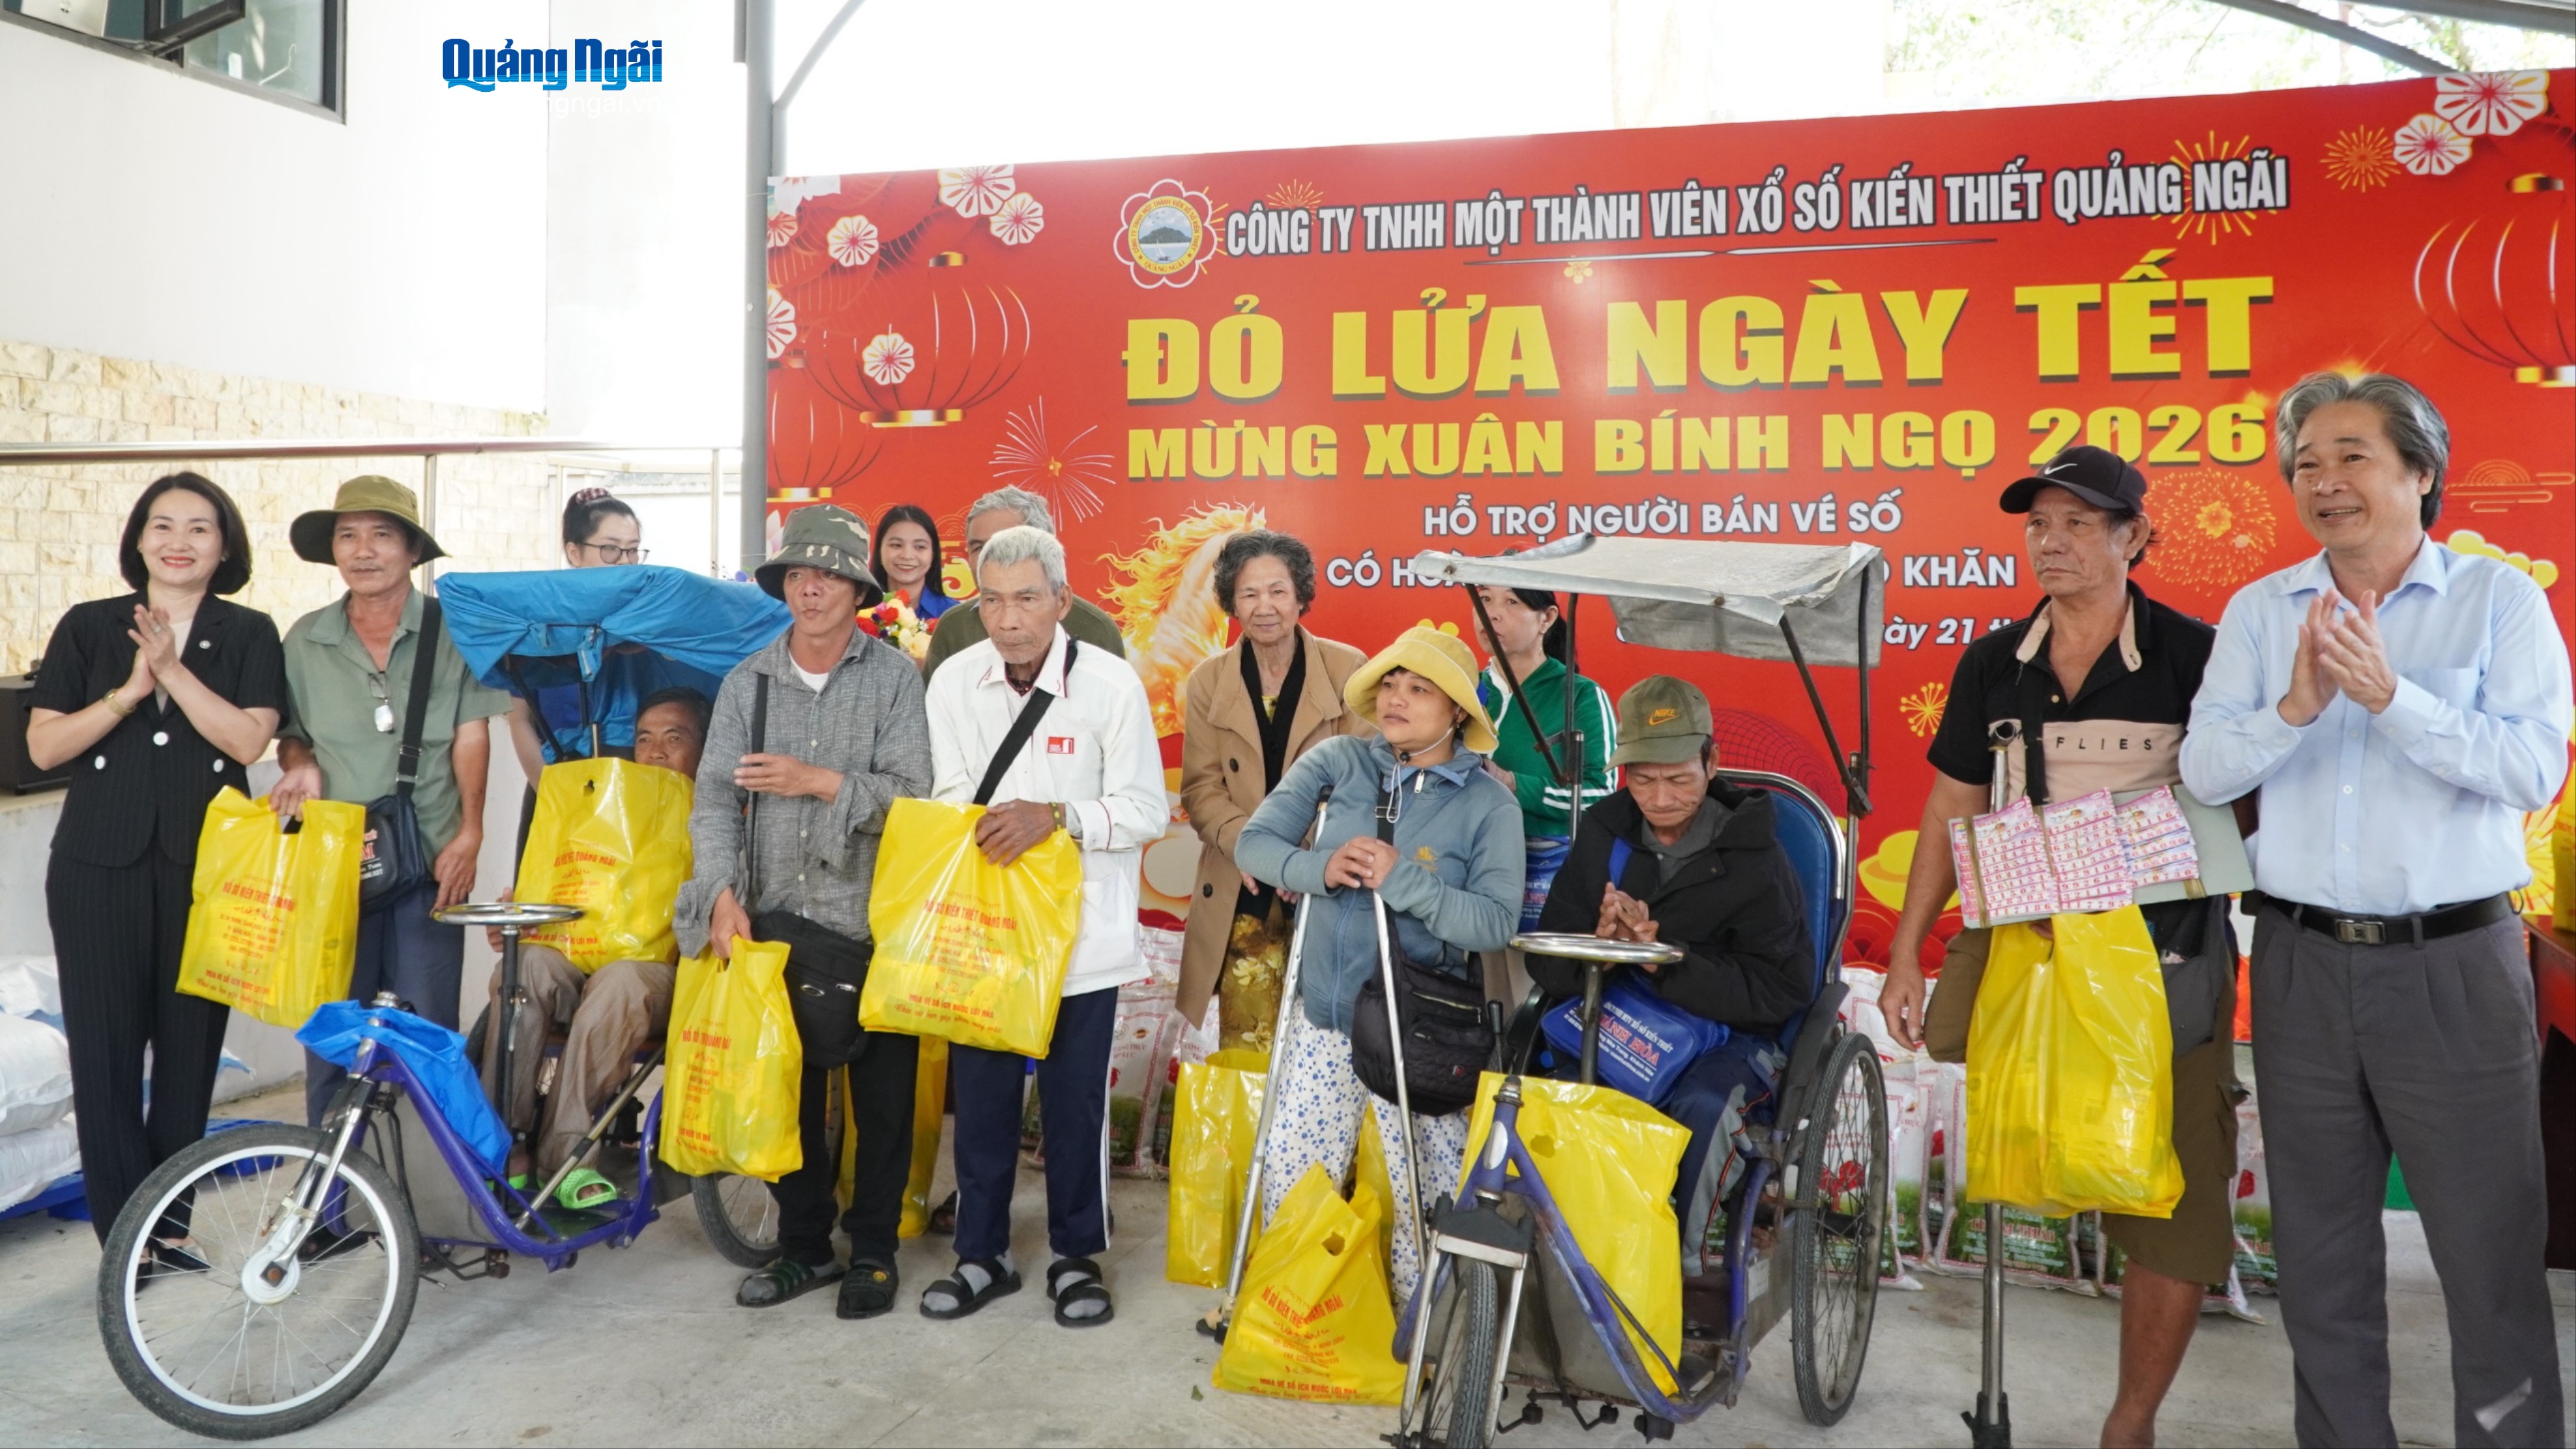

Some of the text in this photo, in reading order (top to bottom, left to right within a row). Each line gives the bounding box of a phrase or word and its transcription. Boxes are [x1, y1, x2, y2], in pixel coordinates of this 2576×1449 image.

[1226, 148, 2288, 256] CÔNG TY TNHH MỘT THÀNH VIÊN XỔ SỐ KIẾN THIẾT QUẢNG NGÃI
[1122, 249, 2273, 401] ĐỎ LỬA NGÀY TẾT
[1127, 404, 2266, 480] MỪNG XUÂN BÍNH NGỌ 2026
[1424, 488, 1903, 543] HỖ TRỢ NGƯỜI BÁN VÉ SỐ
[1326, 550, 1381, 587] CÓ
[1903, 548, 2015, 587] KHĂN
[1935, 619, 1973, 645] 21
[1599, 1013, 1632, 1044] HÁNH
[1629, 1035, 1660, 1066] HÒA
